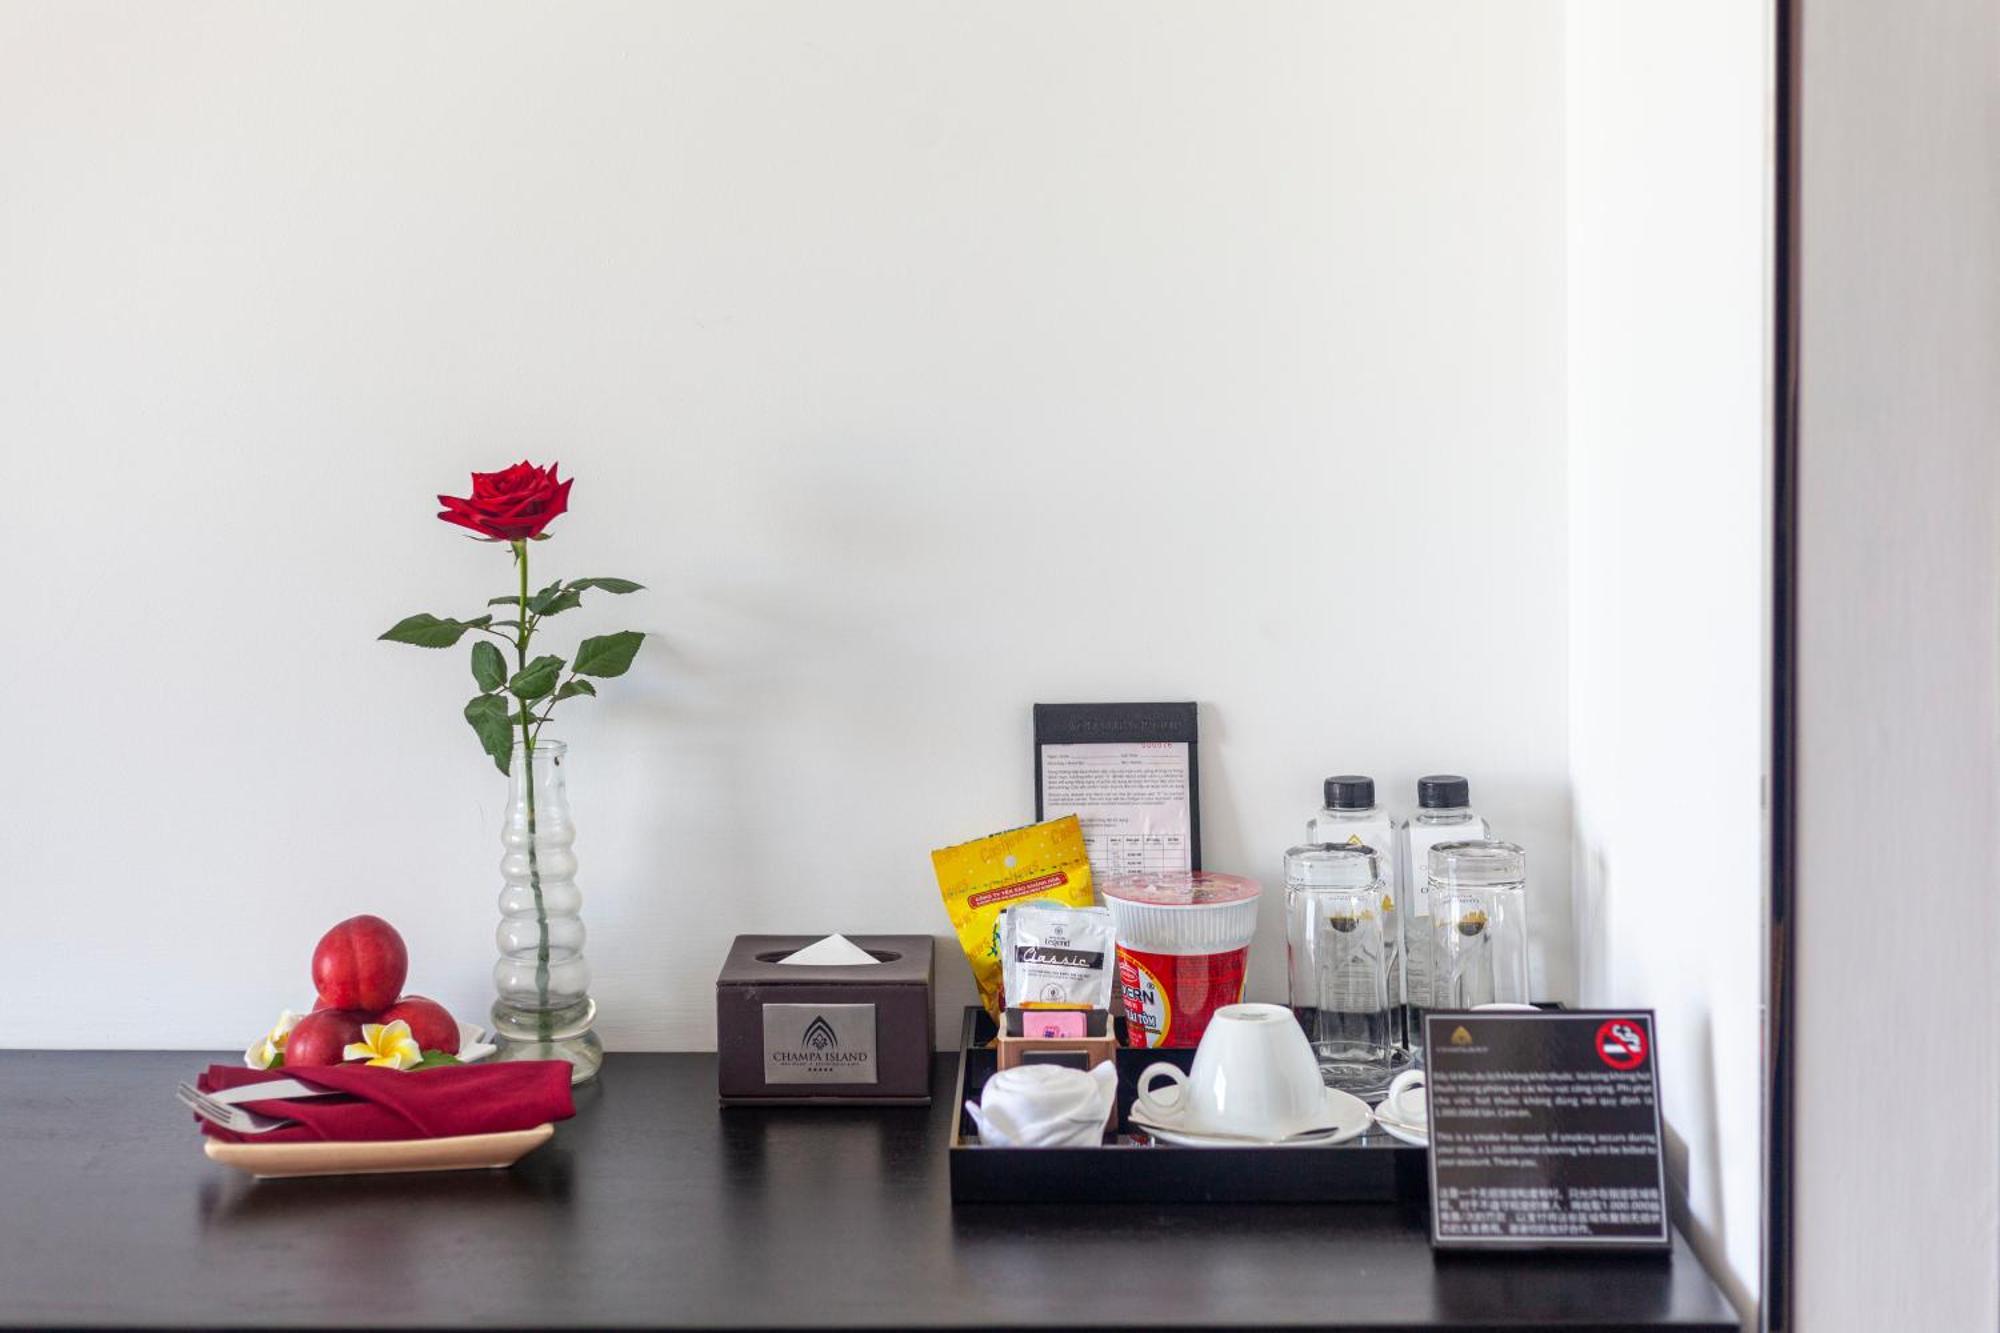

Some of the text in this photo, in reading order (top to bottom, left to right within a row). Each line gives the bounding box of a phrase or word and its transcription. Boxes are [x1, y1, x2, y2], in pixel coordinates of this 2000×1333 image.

[1023, 946, 1090, 968] Classic
[773, 1052, 867, 1061] CHAMPA ISLAND
